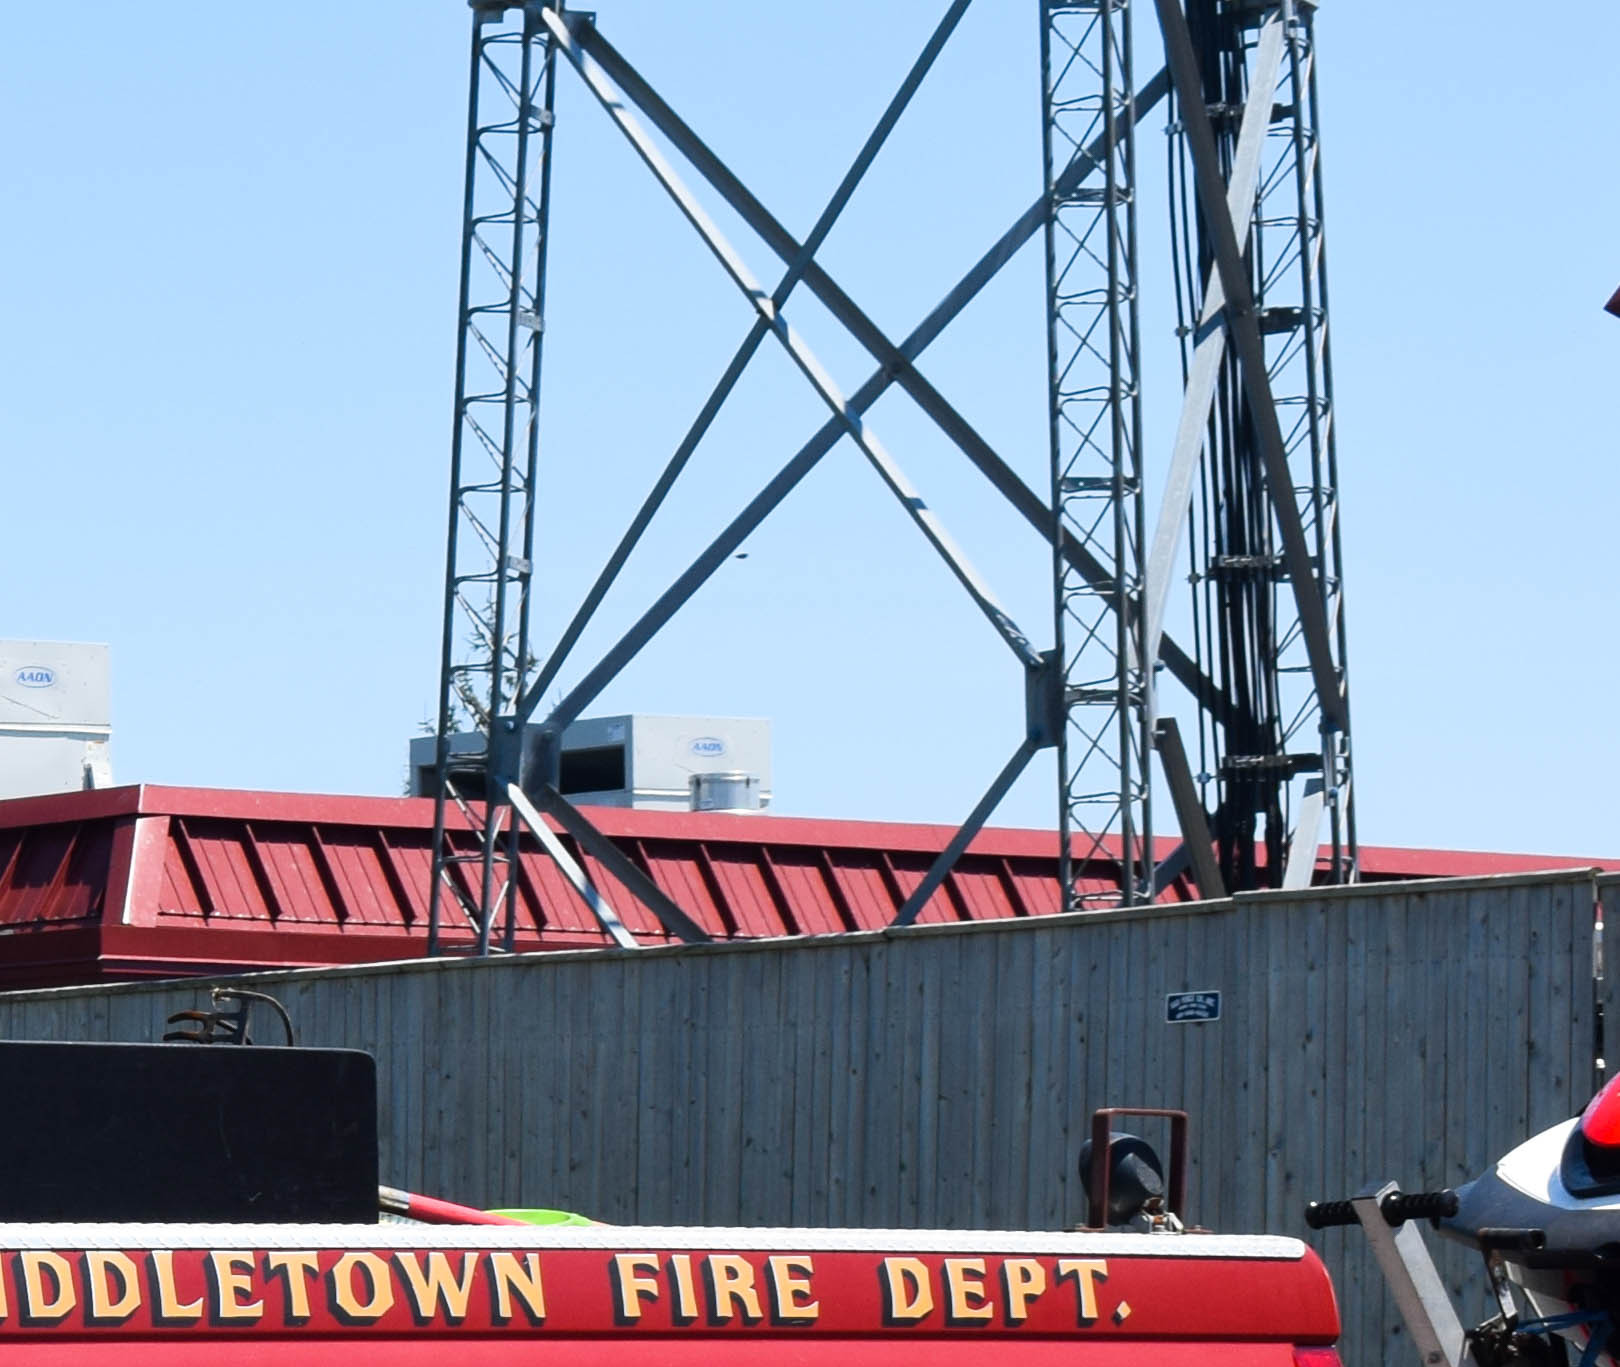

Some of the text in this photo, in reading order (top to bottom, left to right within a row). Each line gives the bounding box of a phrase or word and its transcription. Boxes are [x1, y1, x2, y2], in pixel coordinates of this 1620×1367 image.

[17, 671, 53, 683] AAON
[609, 1253, 820, 1327] FIRE
[880, 1257, 1132, 1327] DEPT.
